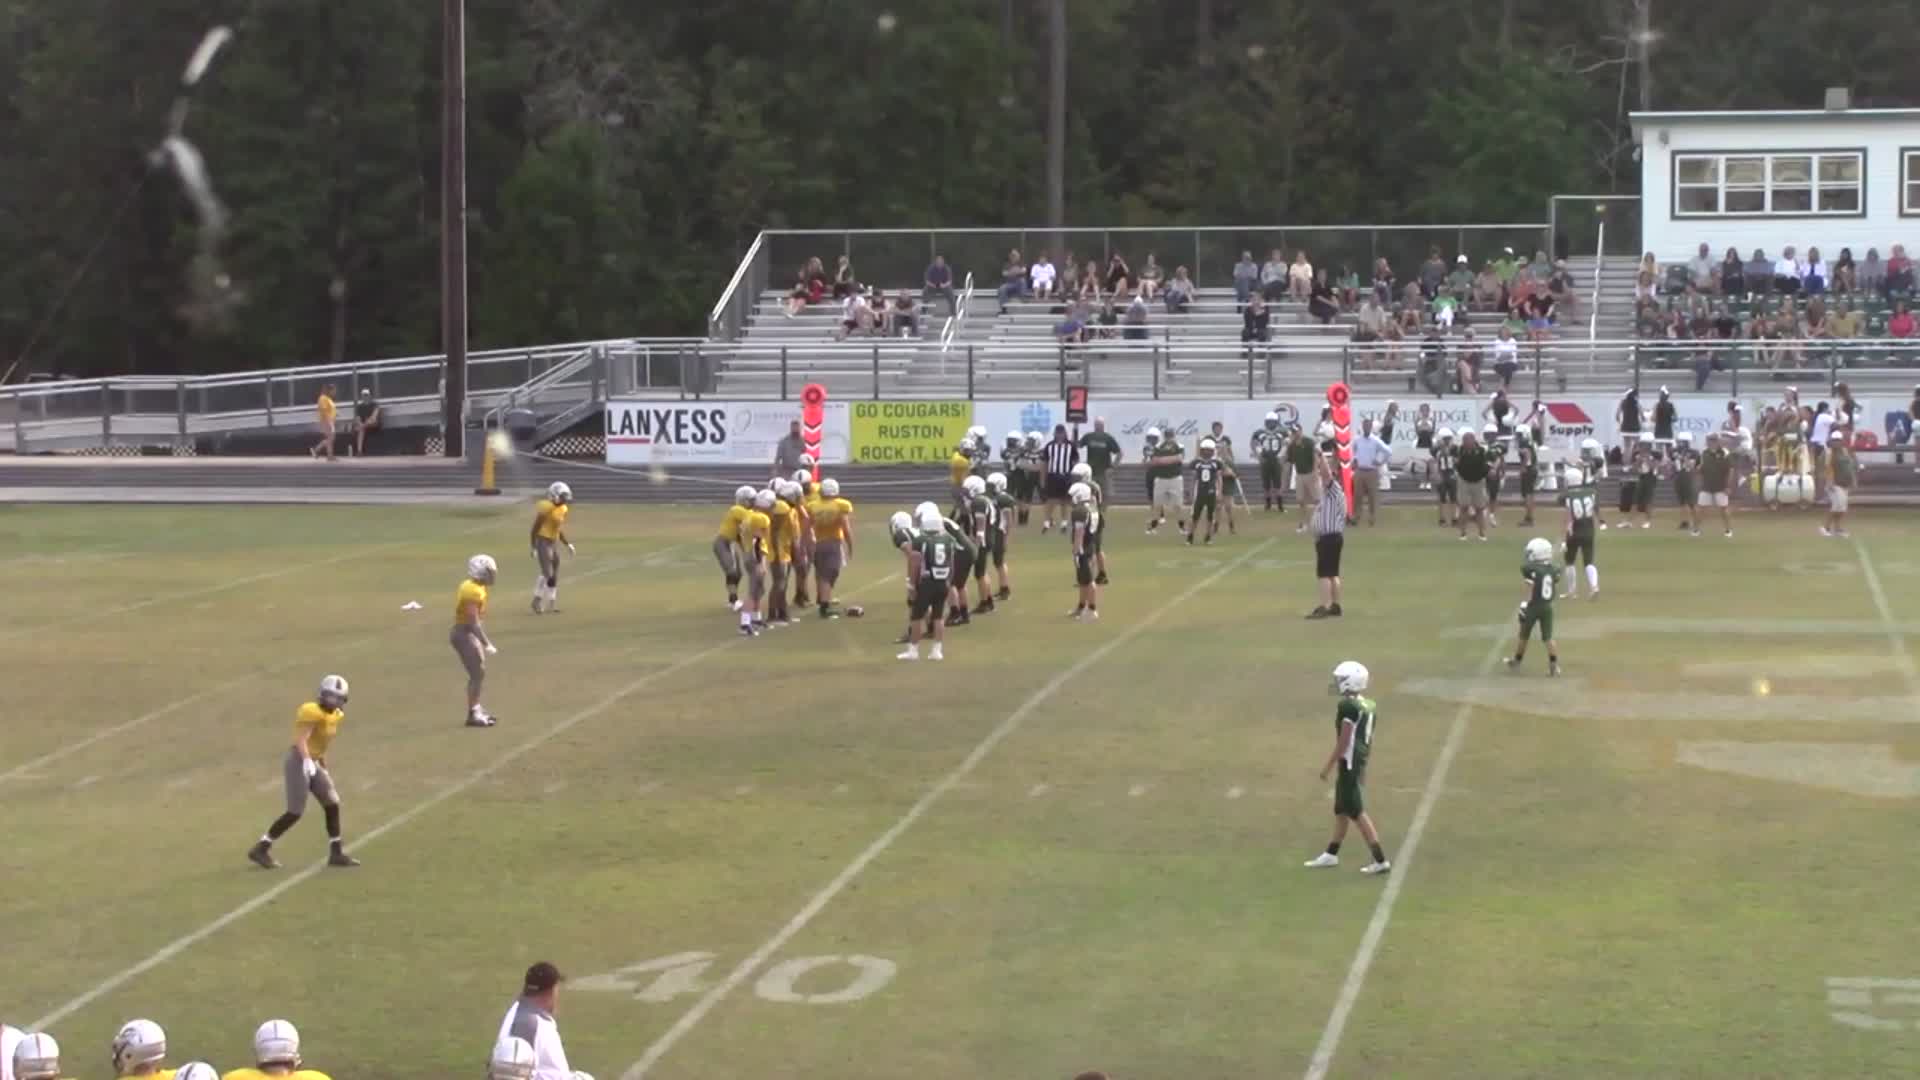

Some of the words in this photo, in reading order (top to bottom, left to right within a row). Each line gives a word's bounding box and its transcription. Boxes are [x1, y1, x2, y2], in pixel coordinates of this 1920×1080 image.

[856, 404, 877, 417] GO
[883, 404, 966, 417] COUGARS!
[607, 409, 726, 445] LANXESS
[878, 425, 944, 438] RUSTON
[1549, 425, 1594, 435] Supply
[861, 446, 902, 460] ROCK
[1541, 574, 1553, 600] 6
[566, 951, 897, 1003] 40
